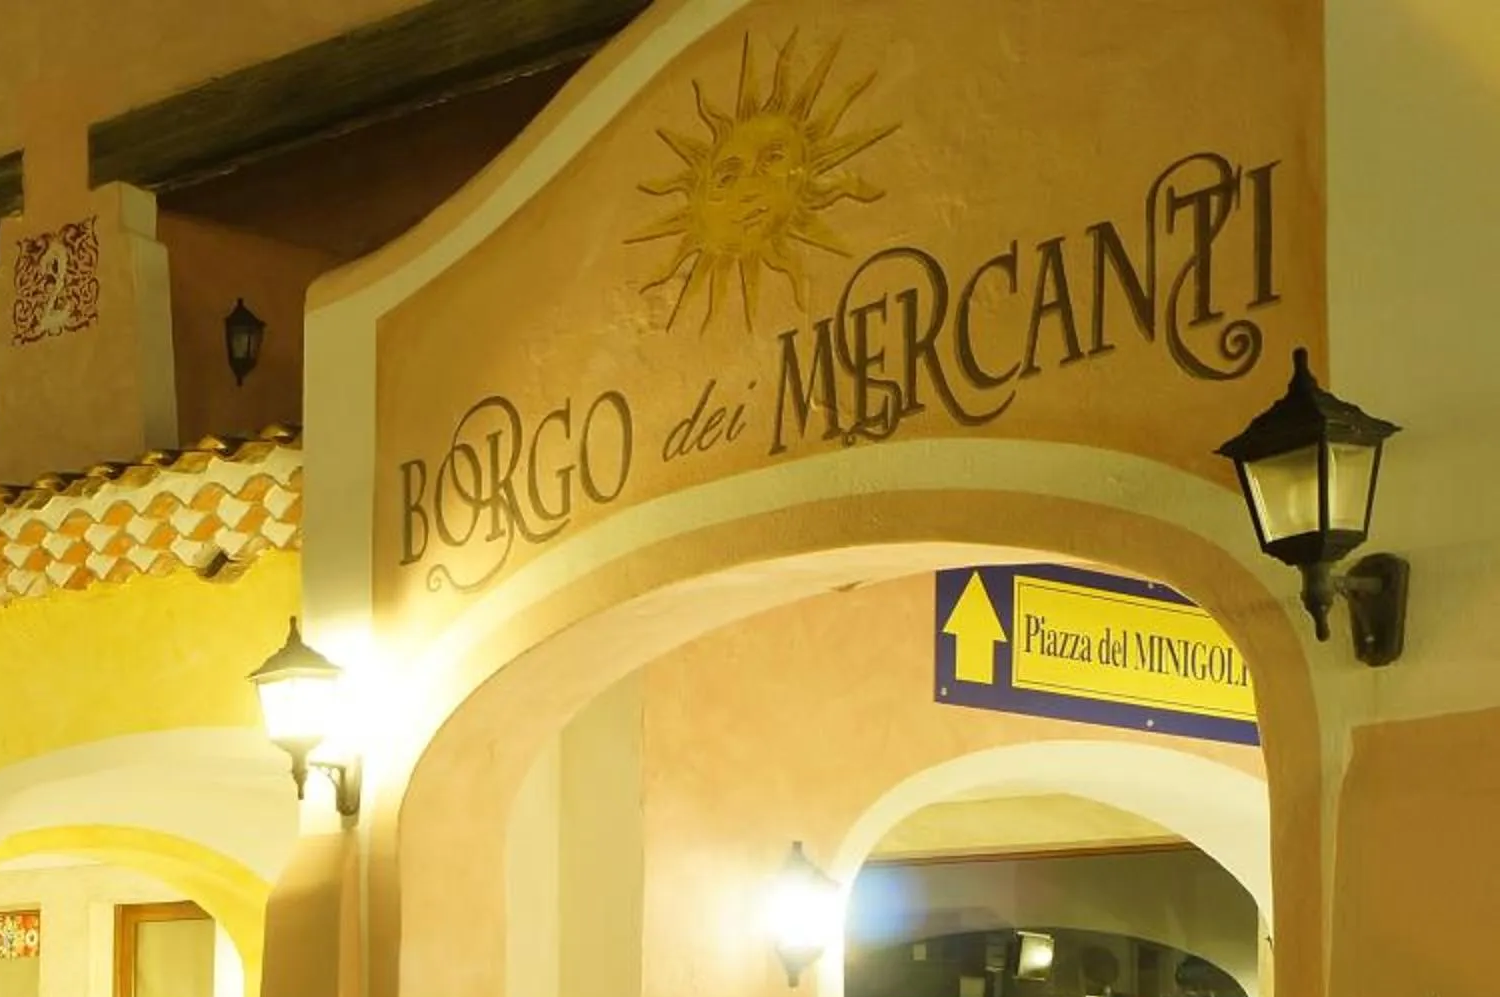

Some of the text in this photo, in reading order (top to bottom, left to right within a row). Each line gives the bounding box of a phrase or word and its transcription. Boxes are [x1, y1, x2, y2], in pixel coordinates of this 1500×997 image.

[399, 152, 1281, 592] BORGO dei MERCANTI
[1024, 613, 1092, 663] Piazza
[1097, 627, 1128, 668] del
